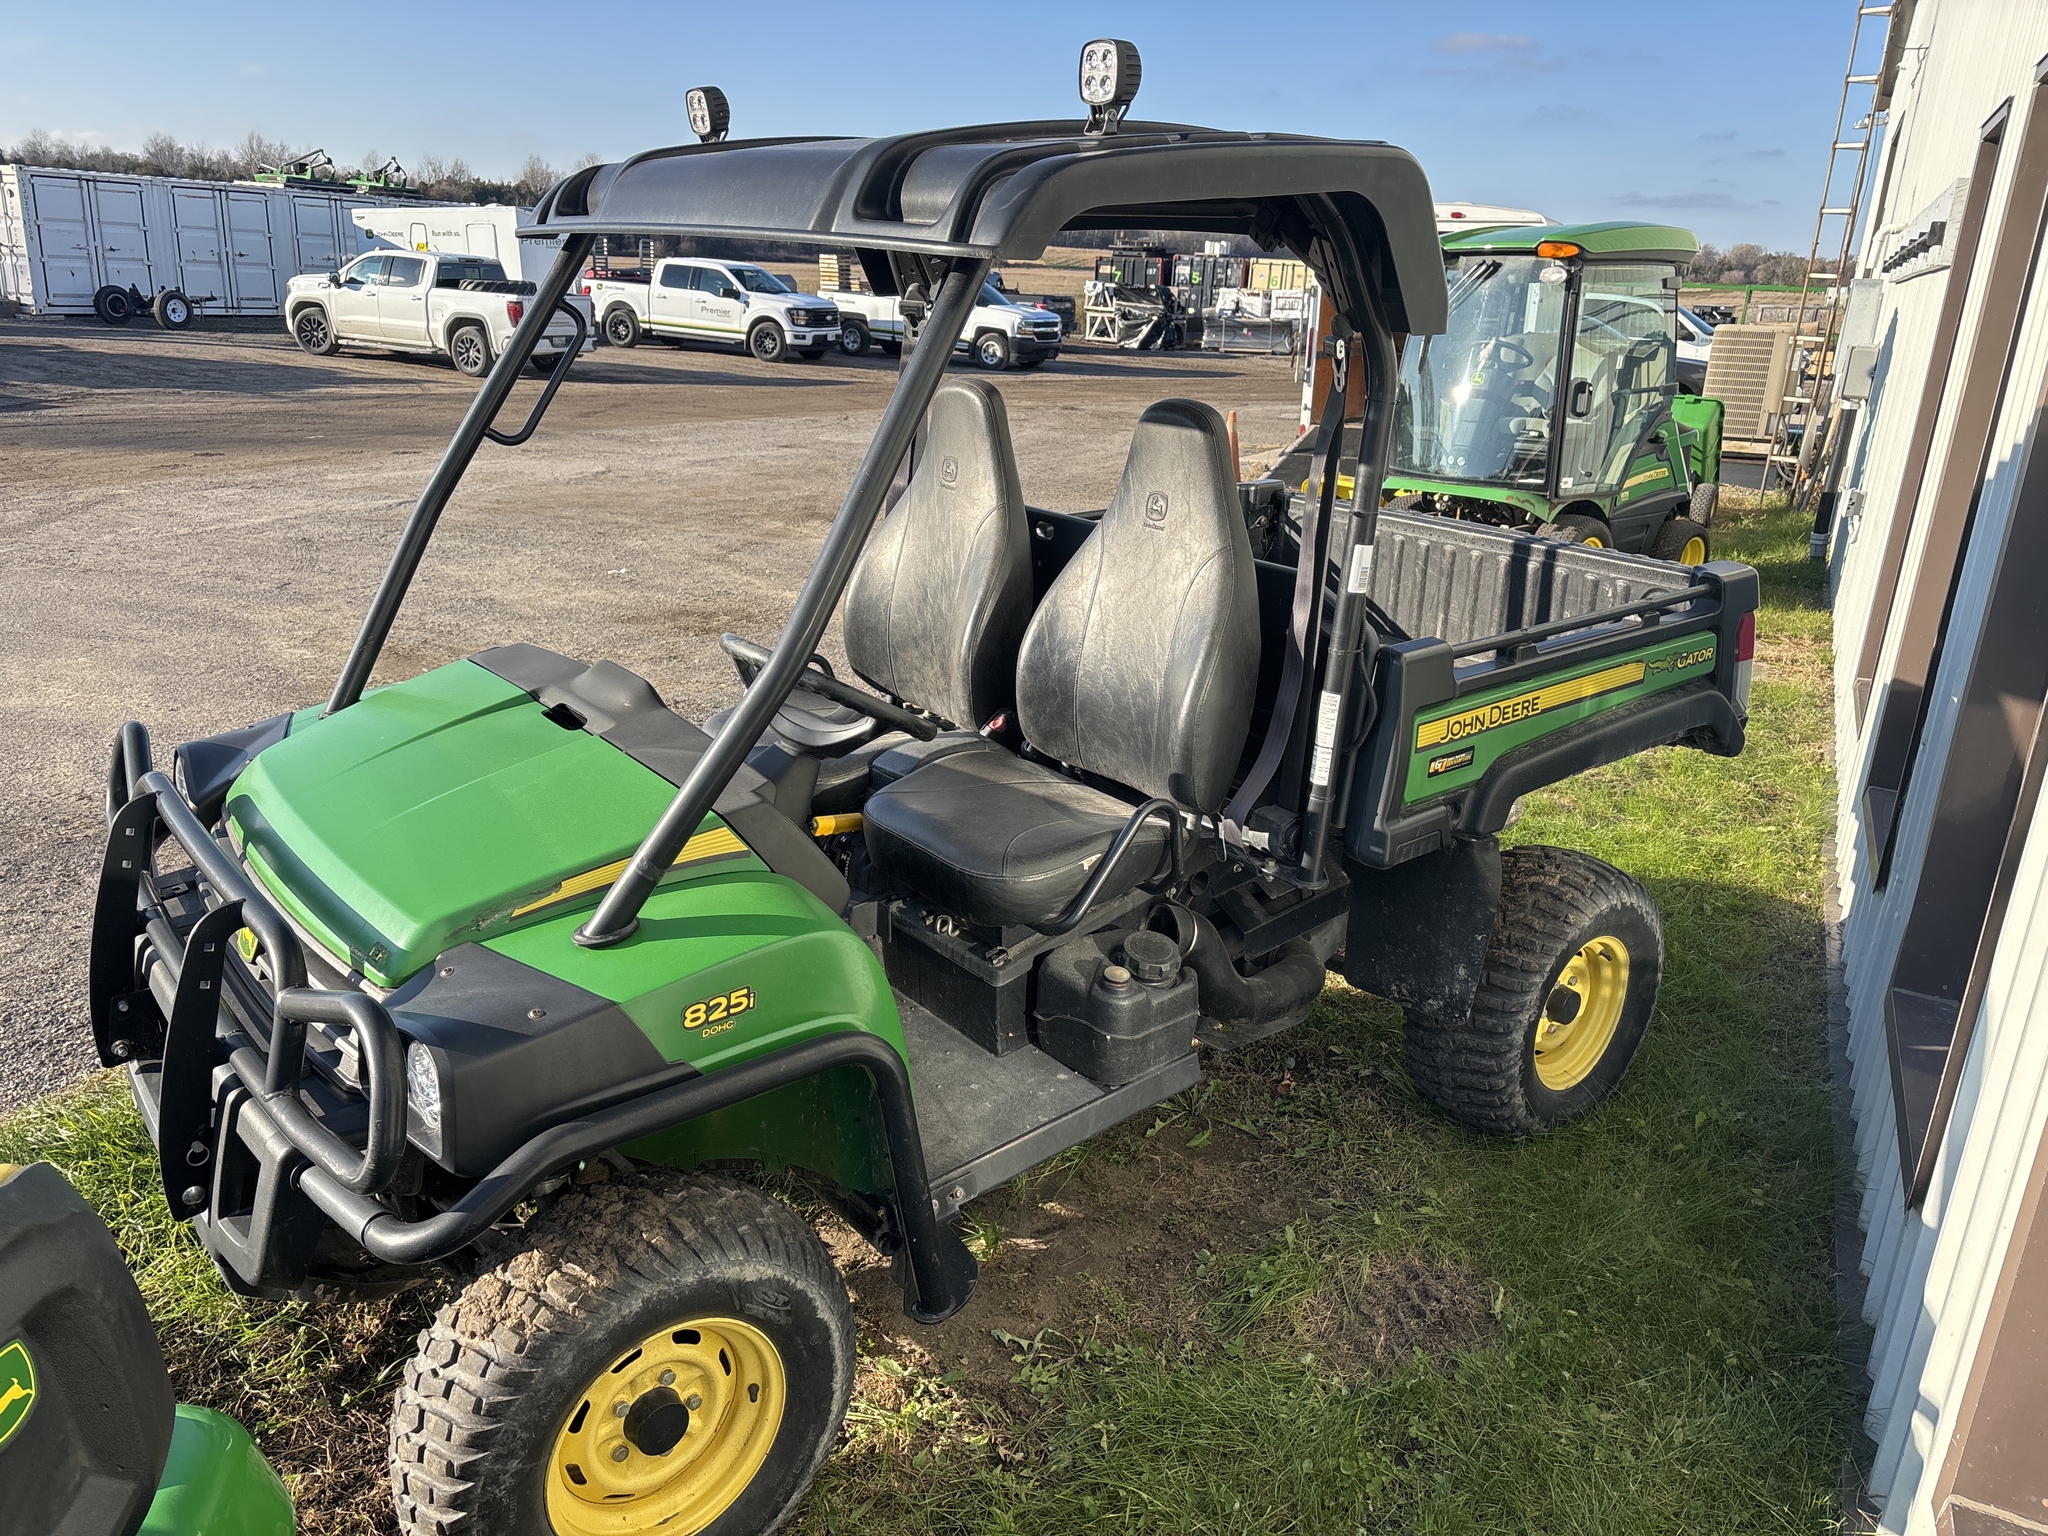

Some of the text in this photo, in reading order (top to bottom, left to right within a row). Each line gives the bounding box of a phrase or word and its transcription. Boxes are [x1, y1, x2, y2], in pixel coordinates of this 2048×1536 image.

[388, 230, 404, 238] DEERE
[431, 229, 441, 237] Run
[442, 229, 453, 237] with
[1114, 270, 1122, 282] 7
[1270, 276, 1279, 288] 6
[701, 305, 732, 316] Premier
[1676, 646, 1715, 669] GATOR
[1440, 695, 1542, 742] JOHN DEERE
[682, 986, 757, 1030] 825i
[701, 1020, 735, 1039] DOHC
[756, 1286, 790, 1307] CST
